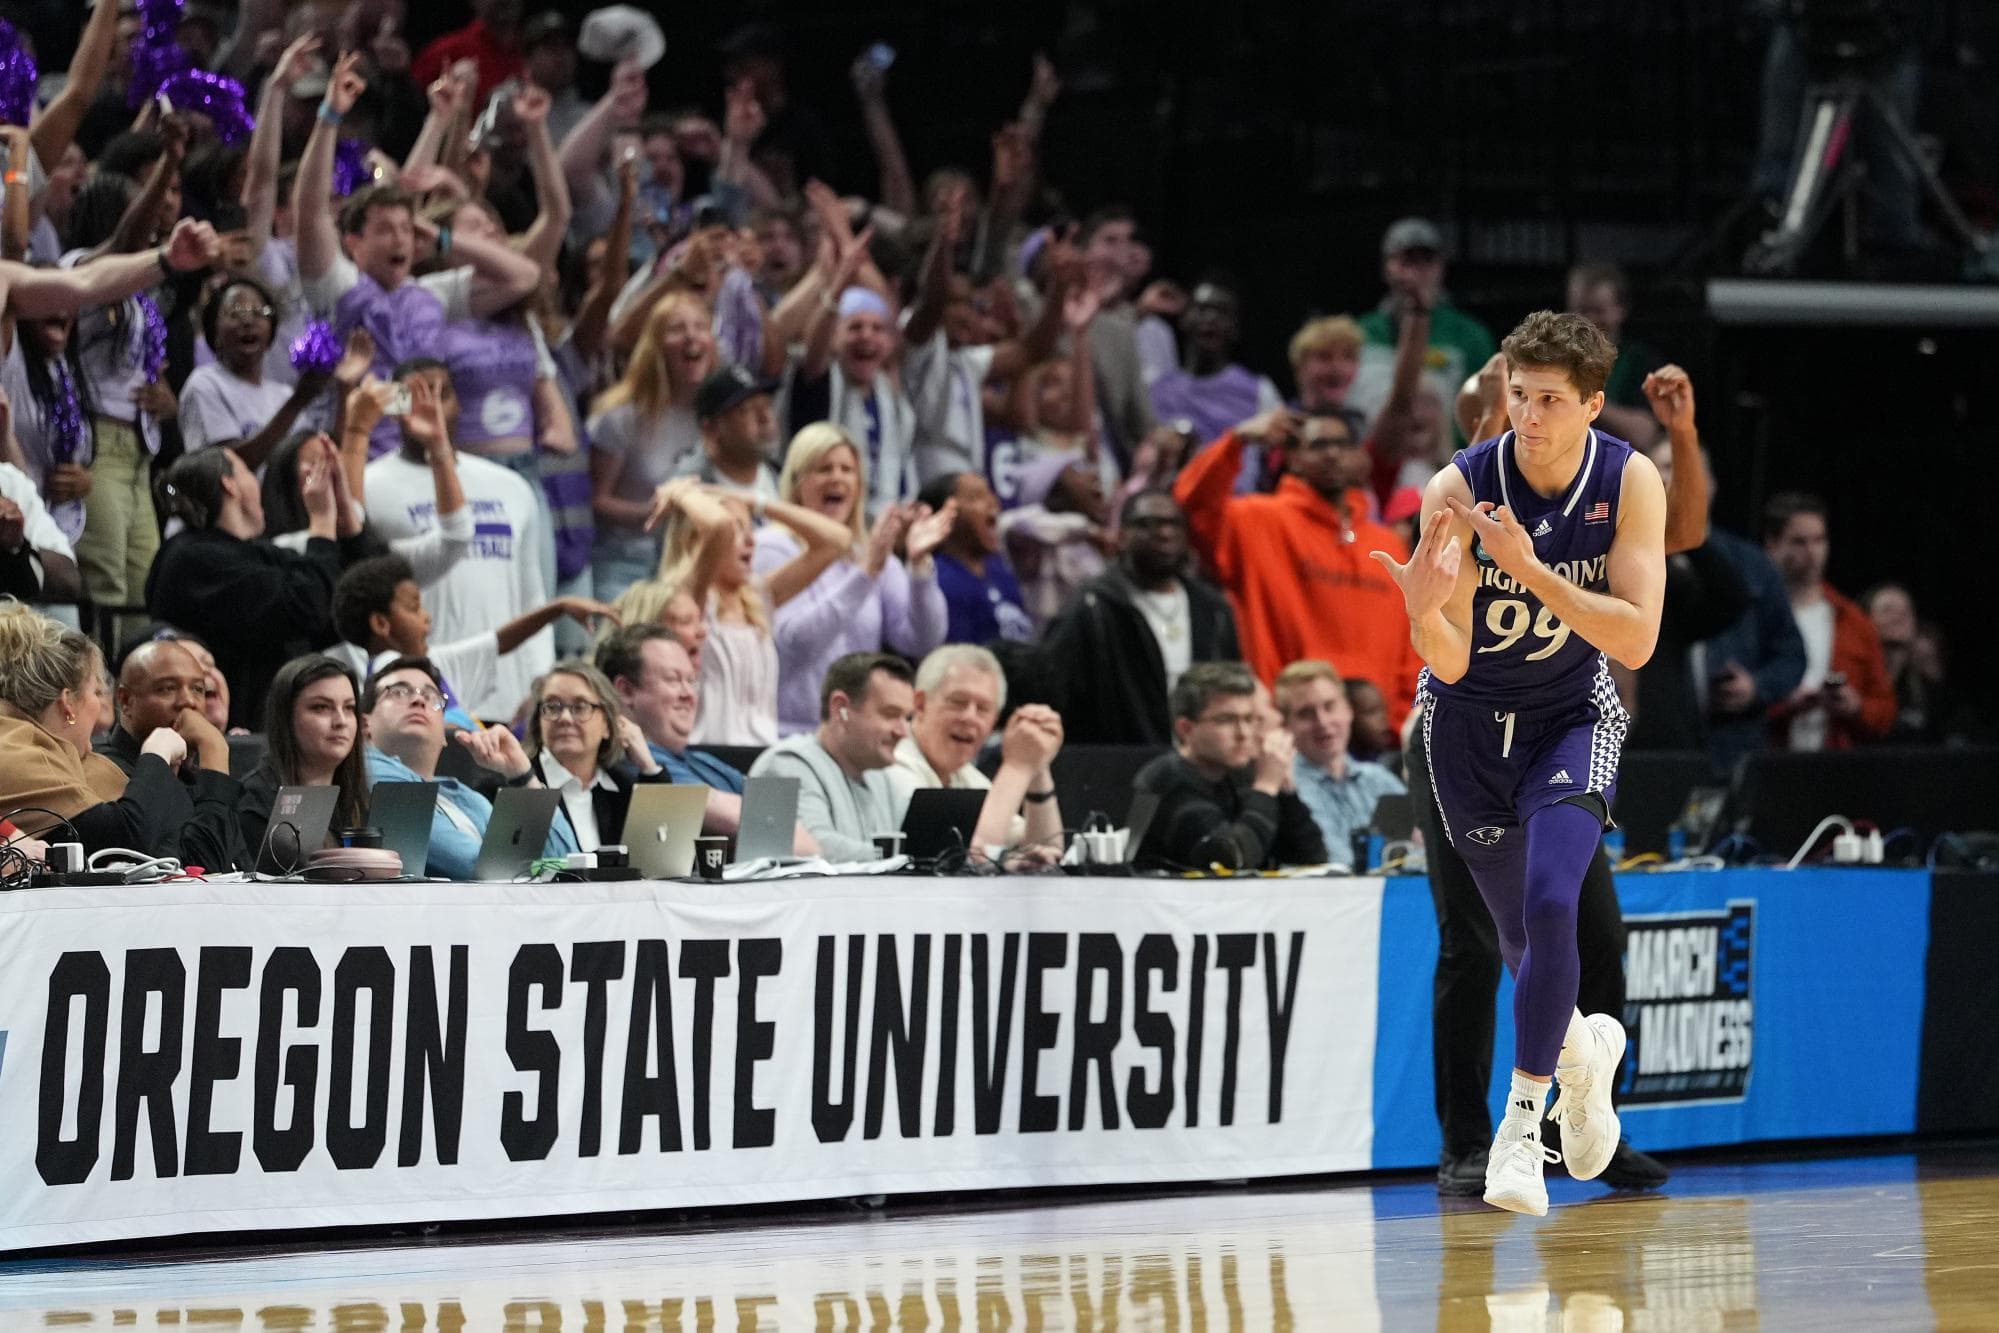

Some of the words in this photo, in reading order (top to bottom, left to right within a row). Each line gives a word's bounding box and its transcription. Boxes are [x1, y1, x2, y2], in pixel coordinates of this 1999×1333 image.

[1532, 526, 1553, 537] adidas
[1543, 553, 1607, 587] OINT
[1477, 599, 1571, 661] 99
[1625, 927, 1719, 1001] MARCH
[35, 944, 468, 1186] OREGON
[500, 938, 783, 1164] STATE
[811, 931, 1305, 1143] UNIVERSITY
[1639, 1000, 1752, 1075] MADNESS
